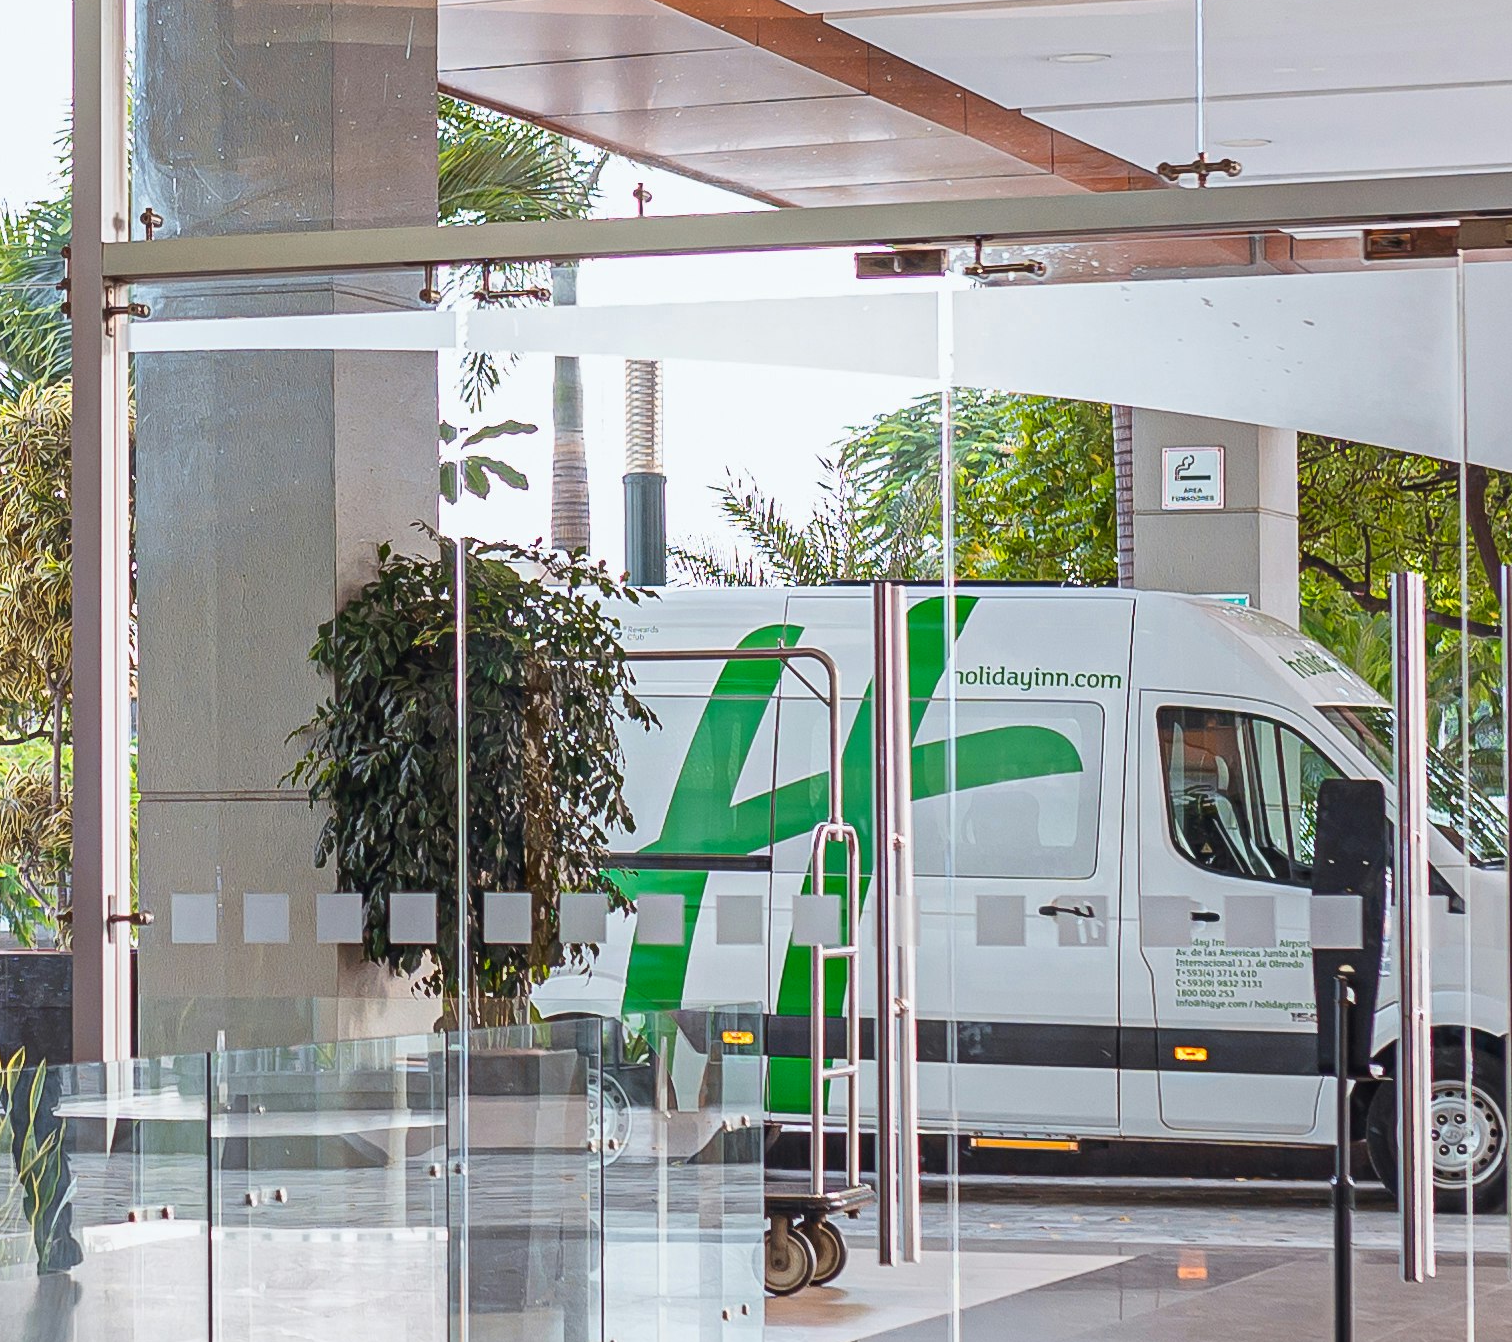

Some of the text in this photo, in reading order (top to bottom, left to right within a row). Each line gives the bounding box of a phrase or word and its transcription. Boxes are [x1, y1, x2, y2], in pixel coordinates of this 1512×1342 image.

[627, 625, 659, 634] Rewards
[1279, 939, 1311, 949] Airport
[1190, 948, 1202, 957] de
[1204, 948, 1217, 957] las
[1175, 958, 1236, 967] Internacional
[1256, 959, 1267, 968] de
[1269, 959, 1305, 969] Olmedo
[1240, 969, 1258, 978] 610
[1176, 989, 1198, 997] 1800
[1199, 989, 1217, 997] 000
[1254, 1000, 1317, 1011] holidayinn.co
